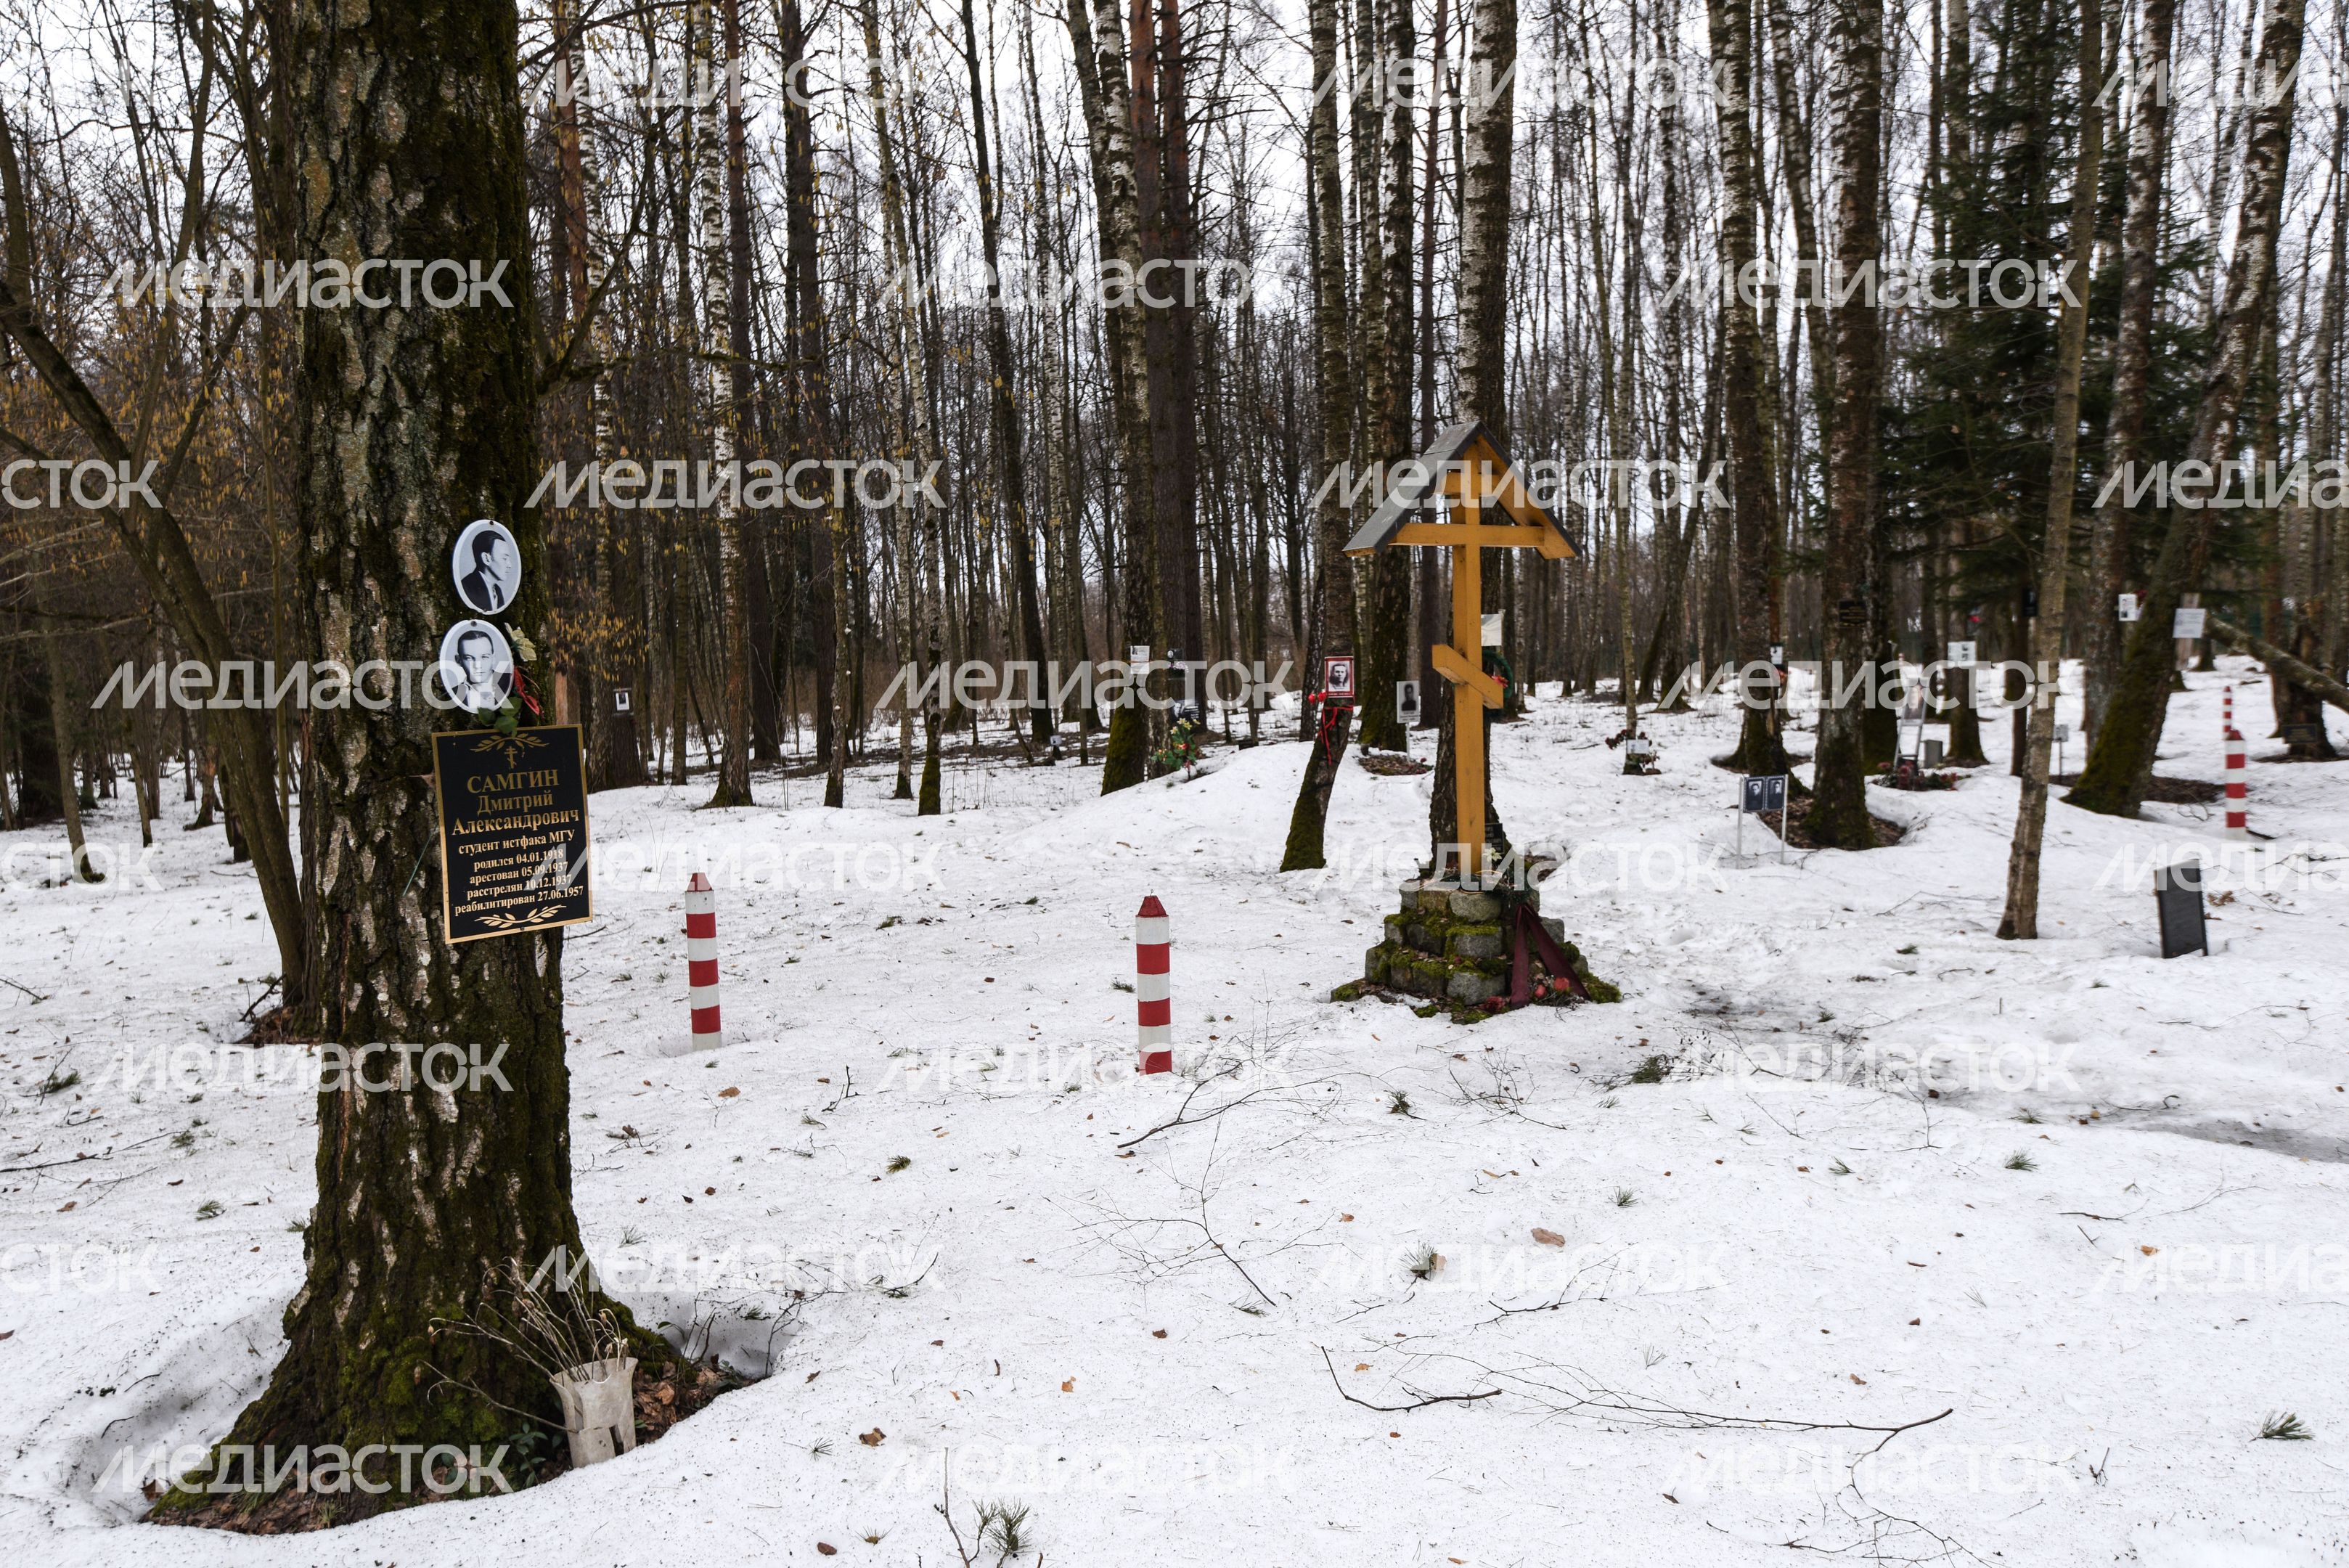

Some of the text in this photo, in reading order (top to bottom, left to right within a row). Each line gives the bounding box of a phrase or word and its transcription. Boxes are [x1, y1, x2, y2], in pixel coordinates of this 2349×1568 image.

[467, 769, 560, 793] САМГИН
[477, 790, 554, 816] Дмитрий
[452, 809, 580, 836] Александрович
[458, 830, 575, 857] студент истфака МГУ
[473, 849, 563, 872] родился 04.01.1918
[470, 862, 568, 885] арестован 05.09.1937
[467, 875, 572, 900] расстрелян 10.12.1937
[454, 886, 584, 916] реабилитирован 27.06.1957
